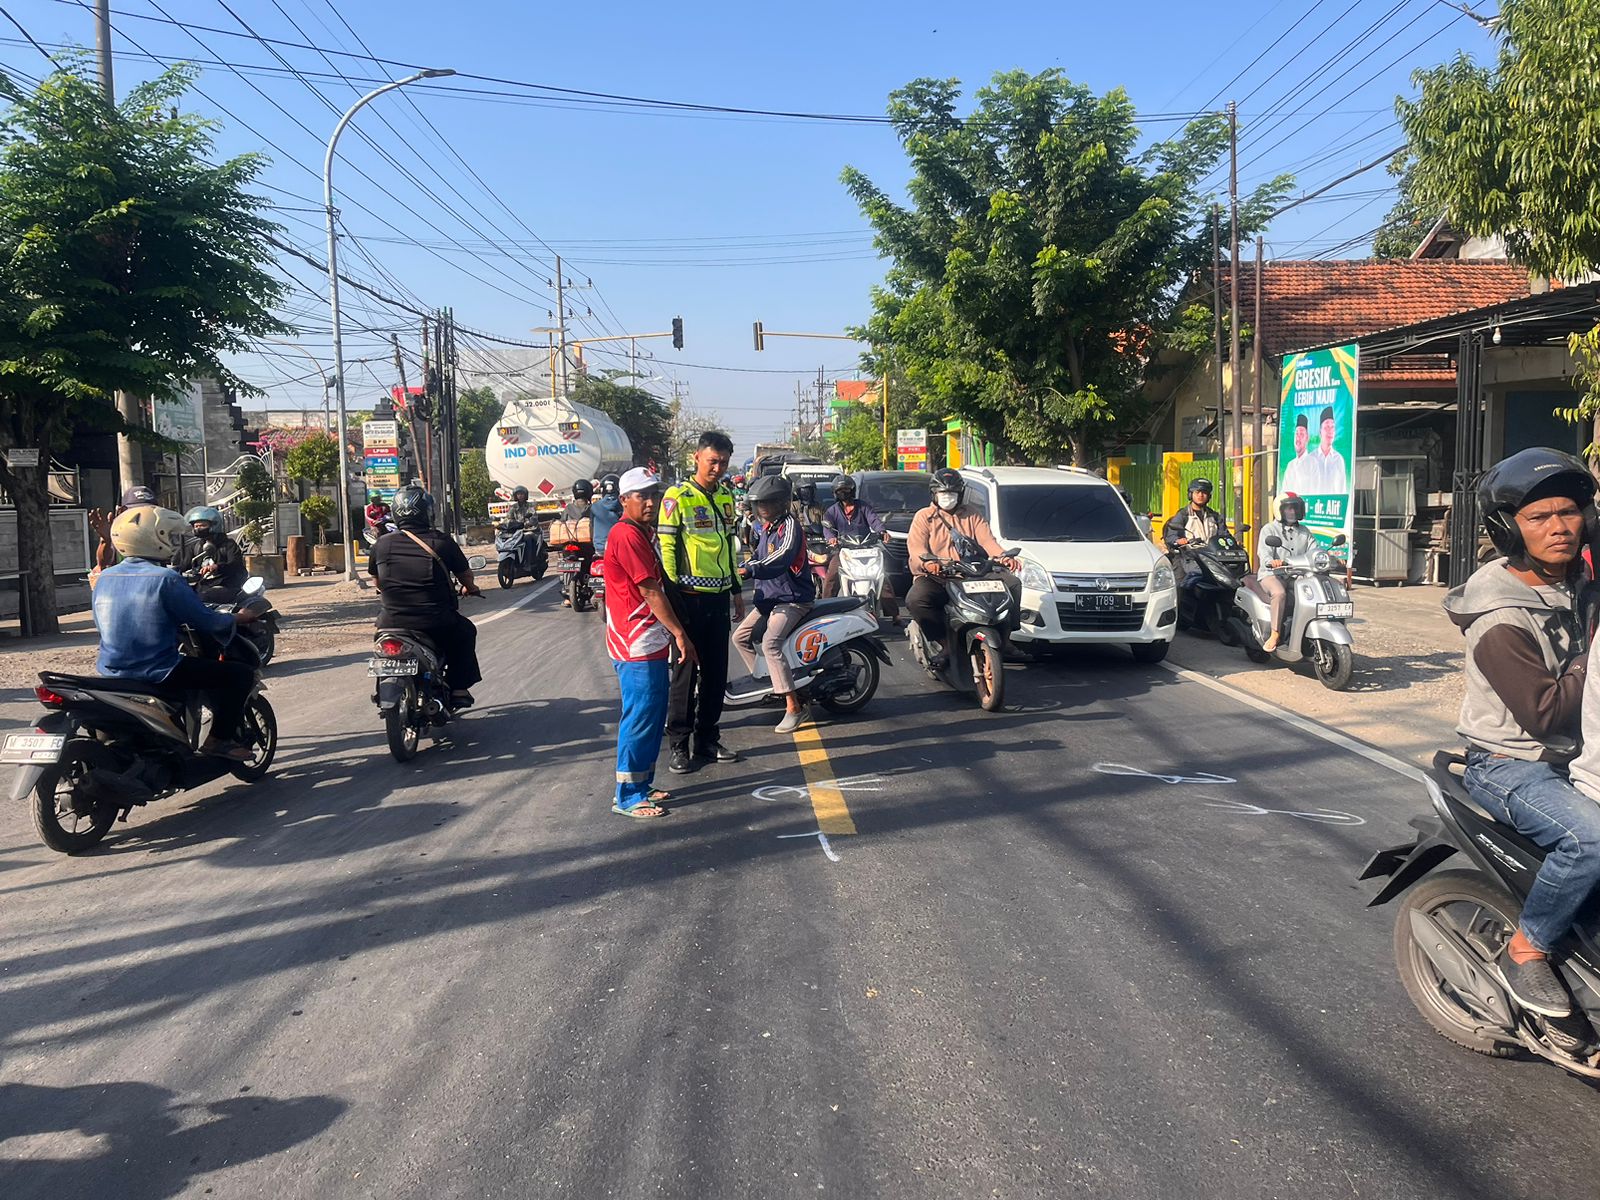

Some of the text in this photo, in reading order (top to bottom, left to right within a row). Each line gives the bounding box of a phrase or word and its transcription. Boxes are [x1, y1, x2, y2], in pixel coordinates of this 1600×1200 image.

[1295, 366, 1331, 390] GRESIK
[1294, 389, 1337, 406] LEBIH MAJU
[504, 443, 580, 459] INDOMOBIL
[1314, 499, 1325, 515] dr.
[1325, 499, 1341, 516] Alif
[1095, 595, 1114, 606] 1789
[1124, 595, 1130, 606] L
[381, 660, 401, 668] 2471
[21, 737, 45, 748] 3507
[50, 737, 63, 749] FC
